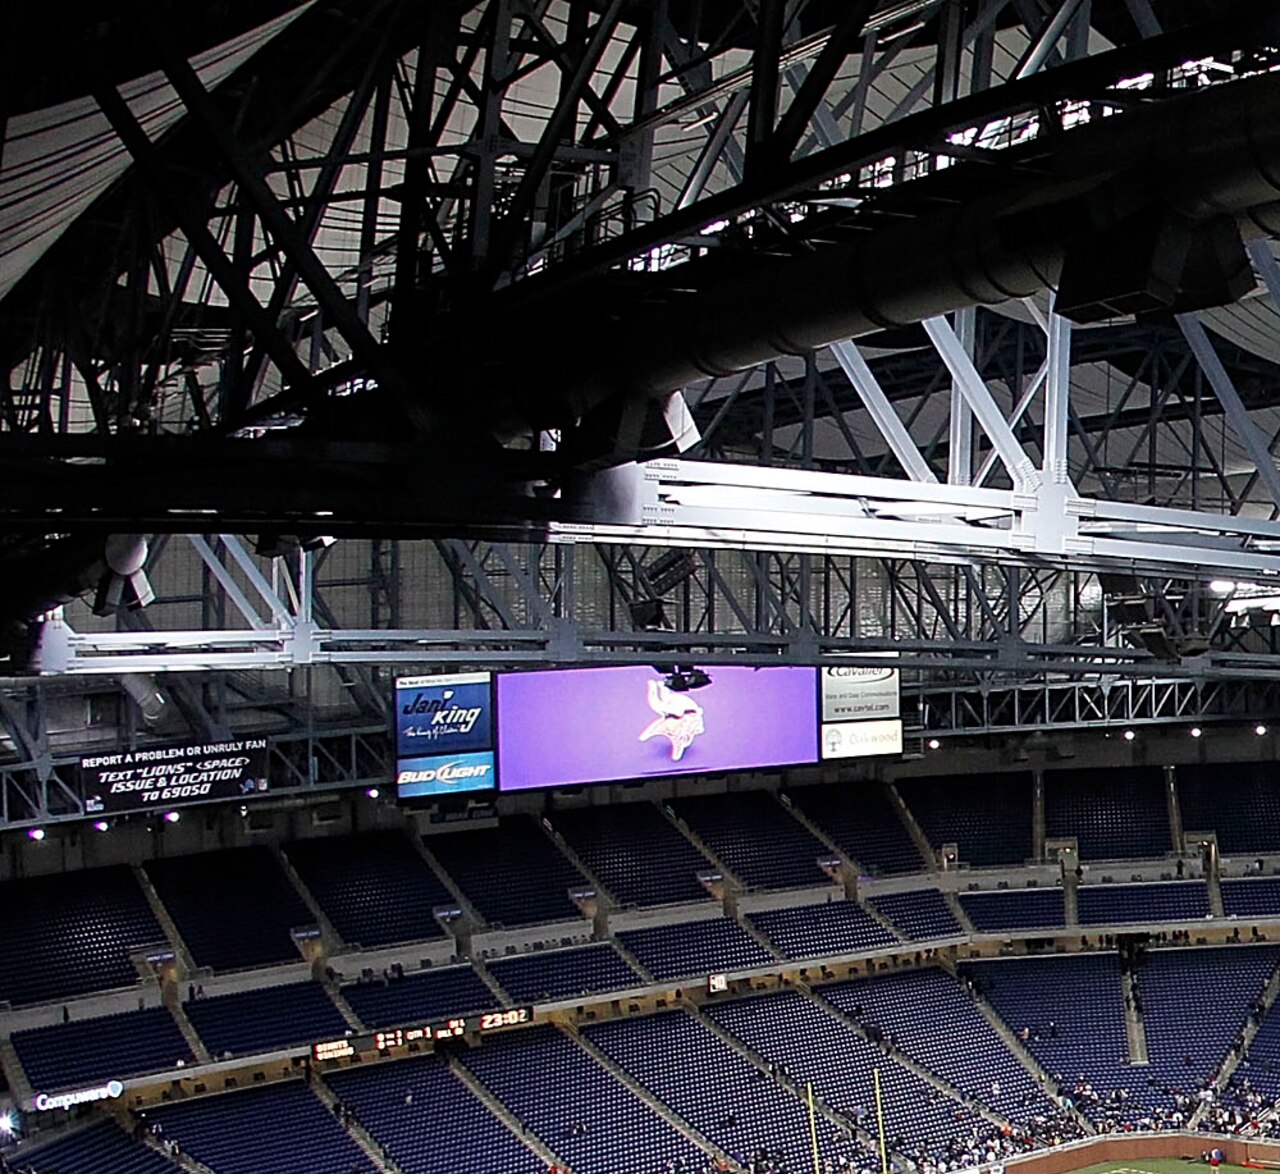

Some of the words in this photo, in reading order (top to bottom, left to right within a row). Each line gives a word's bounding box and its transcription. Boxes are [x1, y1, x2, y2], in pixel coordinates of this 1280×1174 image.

[82, 754, 123, 768] REPORT
[124, 754, 133, 763] A
[135, 747, 184, 762] PROBLEM
[187, 745, 201, 756] OR
[203, 741, 244, 755] UNRULY
[245, 739, 266, 750] FAN
[99, 769, 134, 783] TEXT
[136, 761, 193, 778] "LIONS"
[196, 757, 250, 771] <SPACE>
[110, 778, 155, 794] ISSUE
[156, 776, 168, 787] &
[170, 767, 243, 786] LOCATION
[398, 770, 436, 784] BUD
[442, 765, 491, 778] LIGHT
[141, 791, 159, 802] TO
[161, 783, 211, 801] 69050
